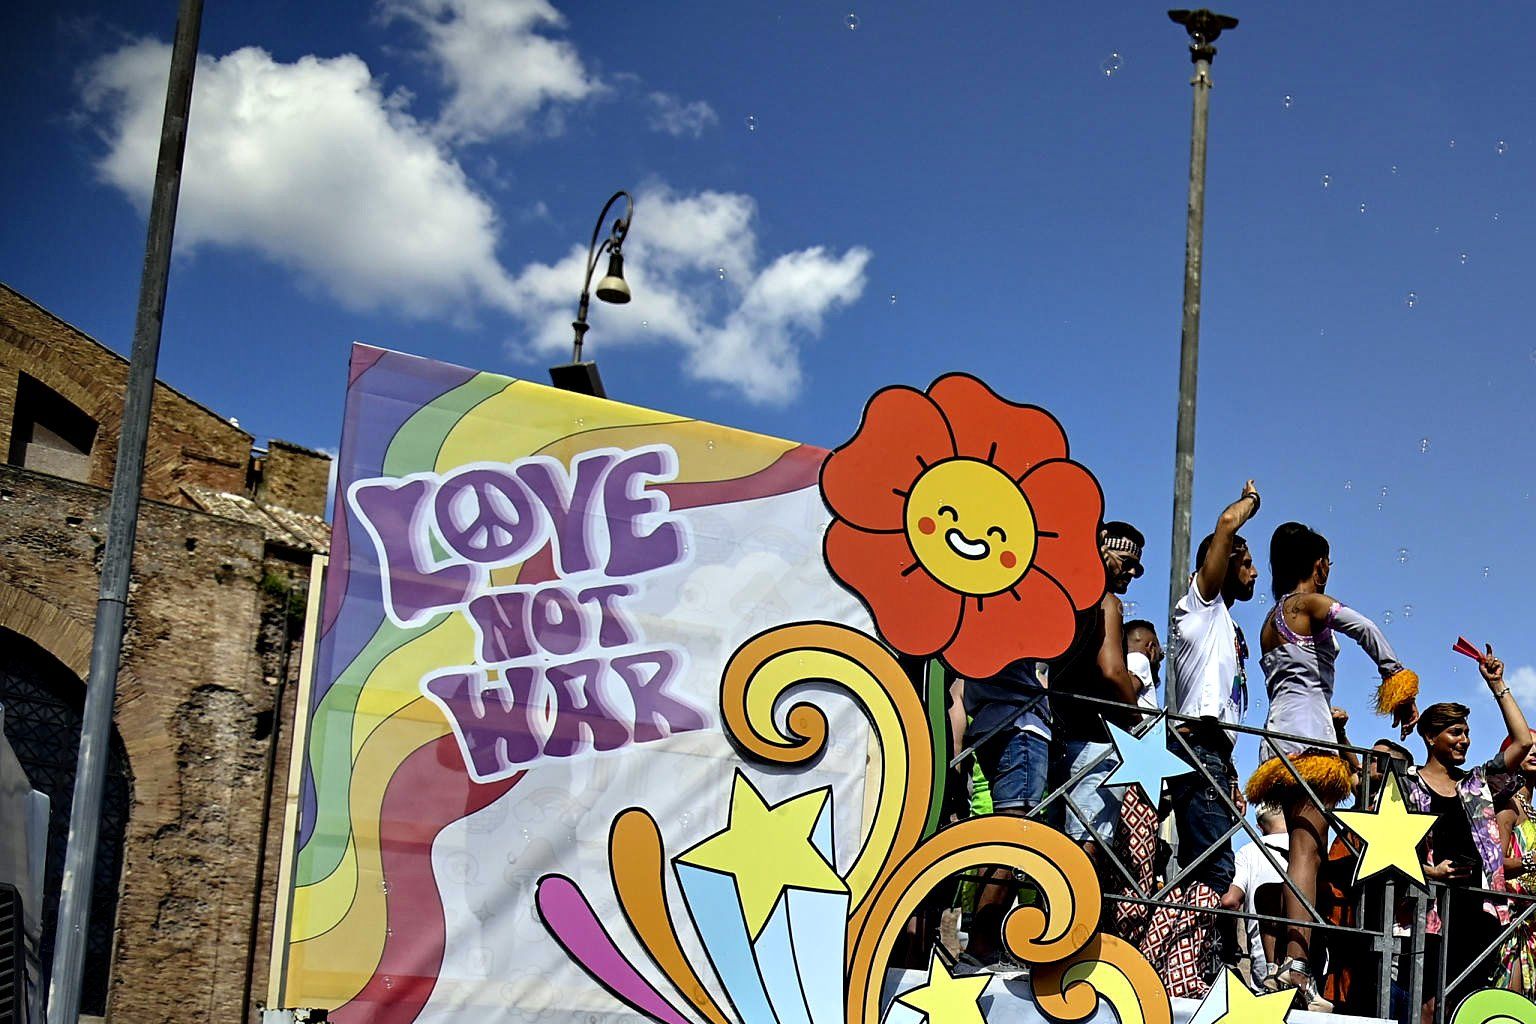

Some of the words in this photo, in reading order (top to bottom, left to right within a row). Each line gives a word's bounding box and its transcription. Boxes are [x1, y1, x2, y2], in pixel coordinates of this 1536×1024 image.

[352, 446, 690, 625] LOVE
[470, 584, 638, 664] NOT
[426, 649, 713, 779] WAR
